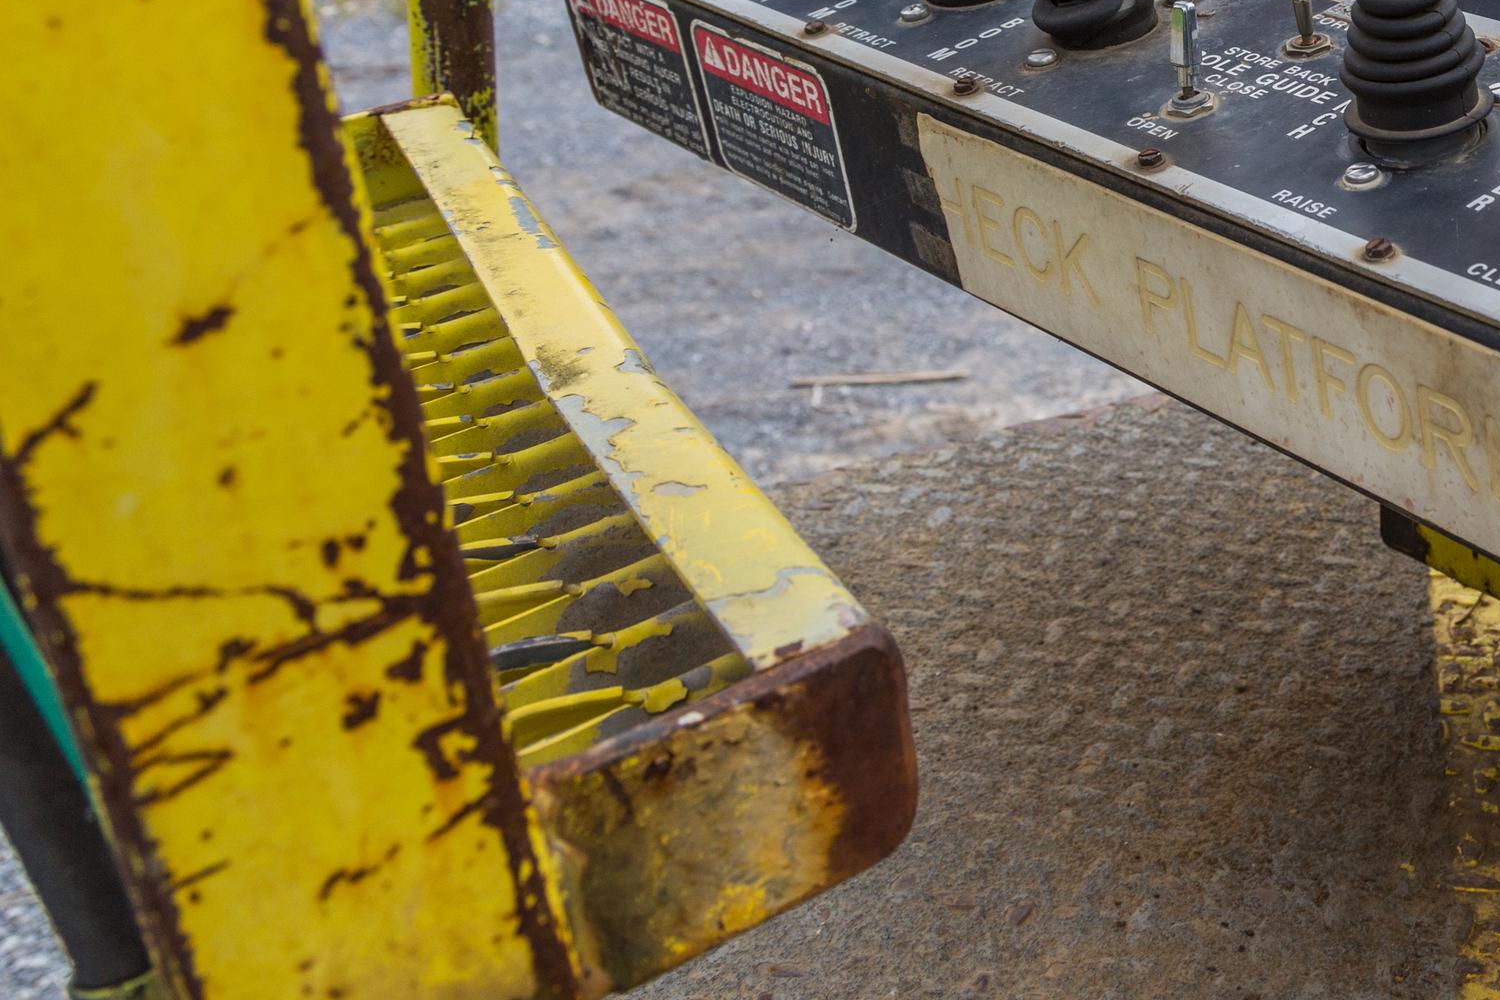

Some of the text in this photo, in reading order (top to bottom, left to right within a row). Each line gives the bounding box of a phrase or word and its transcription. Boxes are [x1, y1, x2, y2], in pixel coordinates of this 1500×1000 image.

[722, 45, 822, 114] DANGER
[1201, 51, 1338, 106] OLE GUIDE
[1224, 46, 1338, 86] STORE BACK
[1204, 73, 1269, 101] CLOSE
[713, 99, 835, 167] DEATH OR SERIOUS INJURY
[1126, 116, 1178, 141] OPEN
[1272, 190, 1337, 219] RAISE
